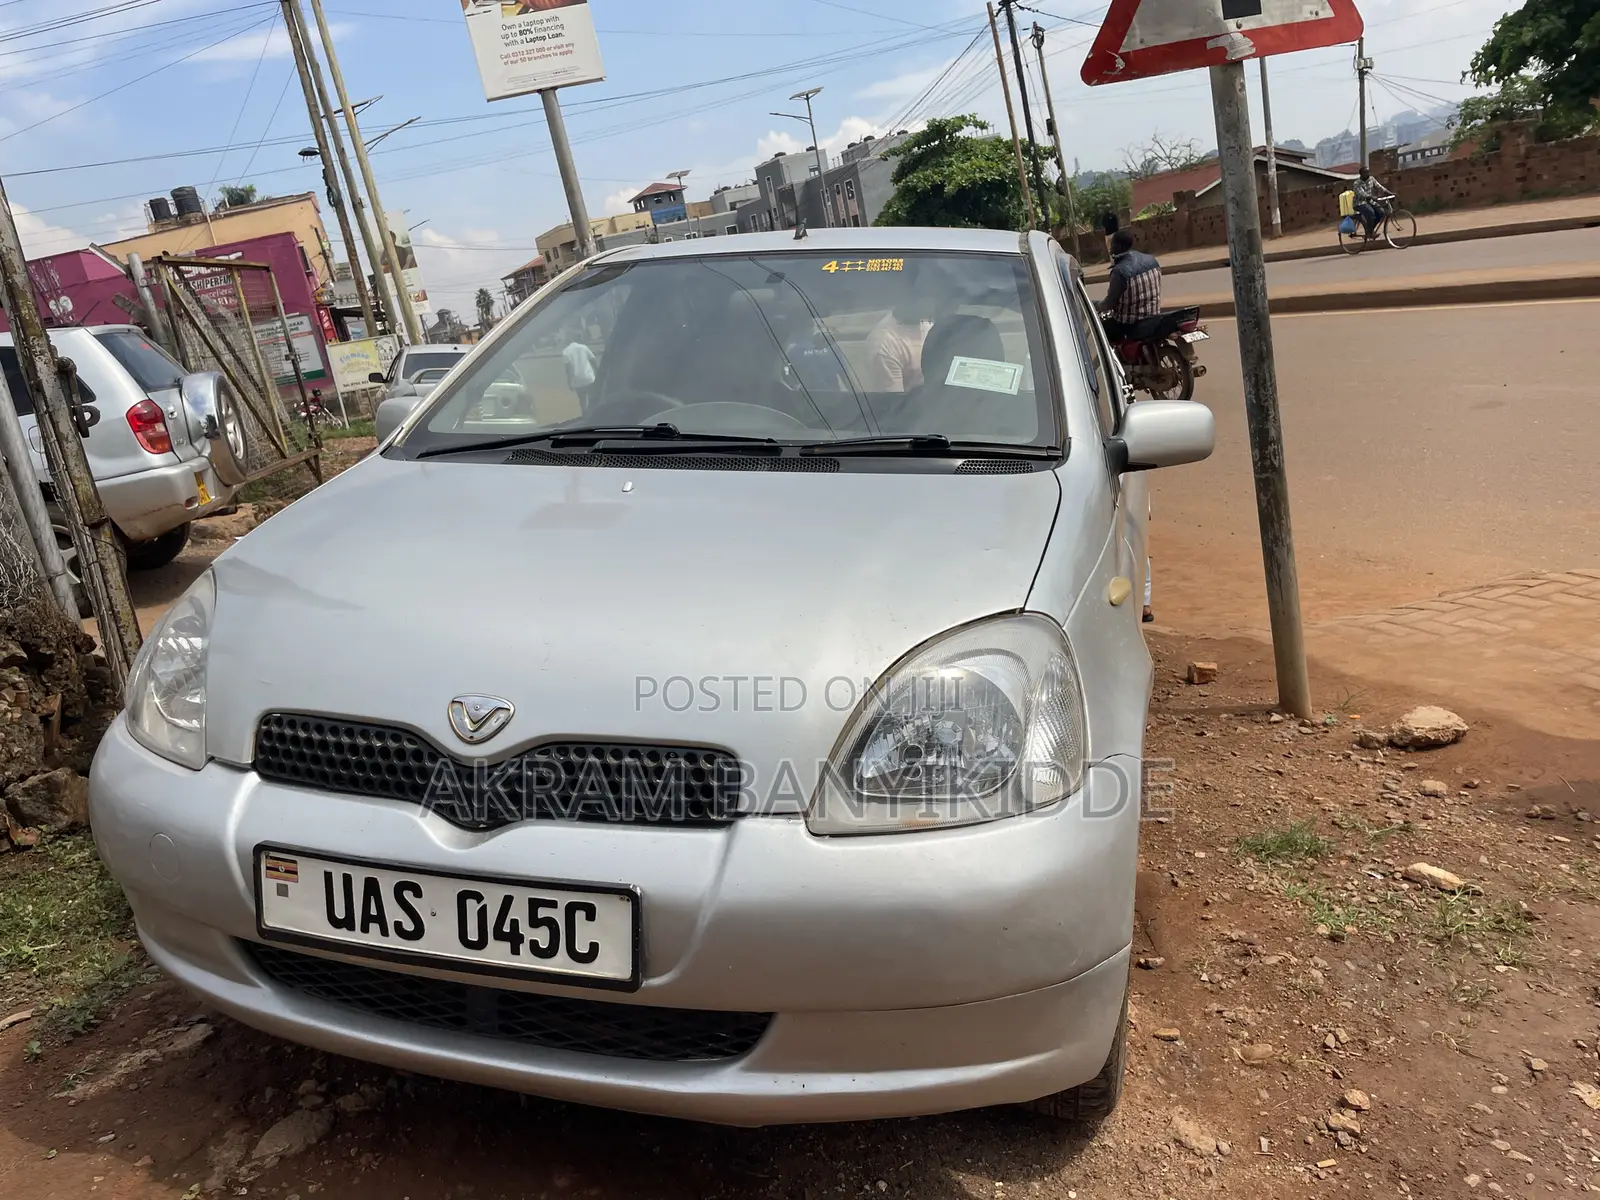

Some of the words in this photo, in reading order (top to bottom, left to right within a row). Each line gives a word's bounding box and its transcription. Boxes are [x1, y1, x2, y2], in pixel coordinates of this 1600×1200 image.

[501, 23, 516, 31] Own
[523, 18, 545, 27] laptop
[545, 15, 560, 23] with
[518, 28, 533, 36] 80%
[534, 23, 564, 33] financing
[504, 39, 519, 47] with
[525, 35, 547, 44] Laptop
[547, 31, 565, 39] Loan.
[527, 52, 552, 62] branches
[822, 260, 839, 273] 4
[323, 869, 426, 941] UAS
[456, 889, 600, 964] 045C
